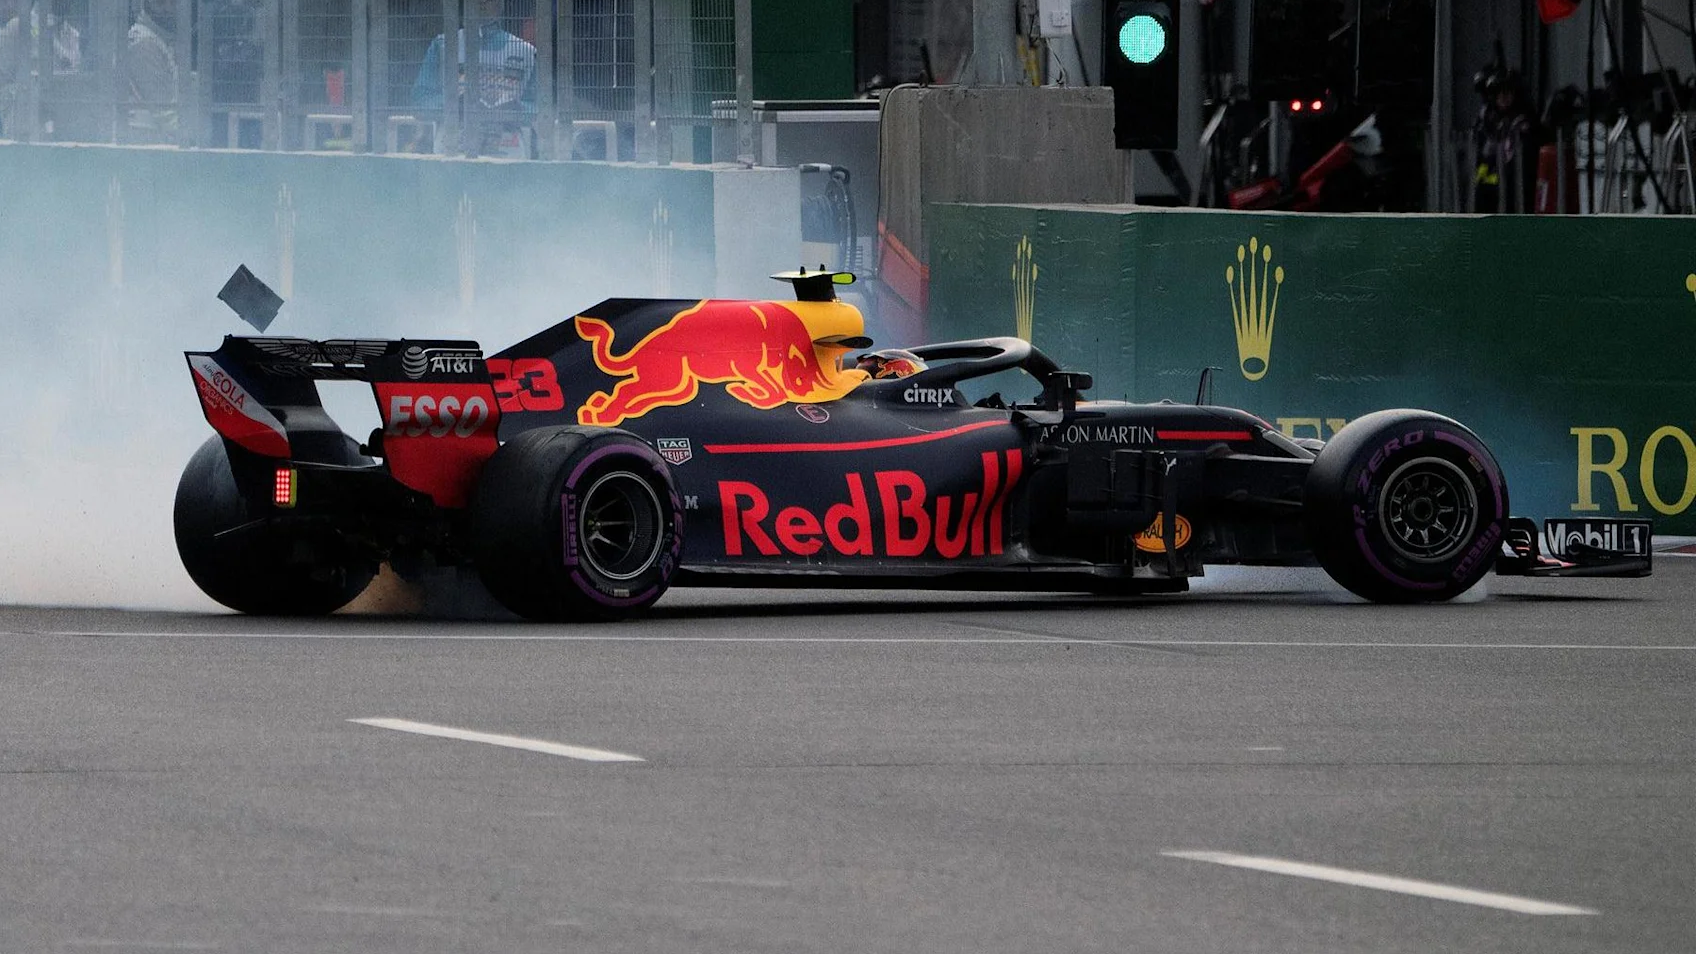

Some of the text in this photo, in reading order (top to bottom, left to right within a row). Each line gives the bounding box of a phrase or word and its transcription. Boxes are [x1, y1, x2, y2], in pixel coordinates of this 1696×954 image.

[431, 352, 478, 373] AT&T
[213, 371, 245, 409] COLA
[485, 357, 565, 413] 33
[386, 395, 489, 438] ESSO
[660, 440, 687, 448] TAG
[1039, 425, 1155, 444] AON MARTIN
[661, 451, 690, 462] HEUER
[1356, 429, 1425, 495] ZERO
[717, 448, 1024, 559] Red Bull
[1546, 522, 1641, 555] Mobil 1
